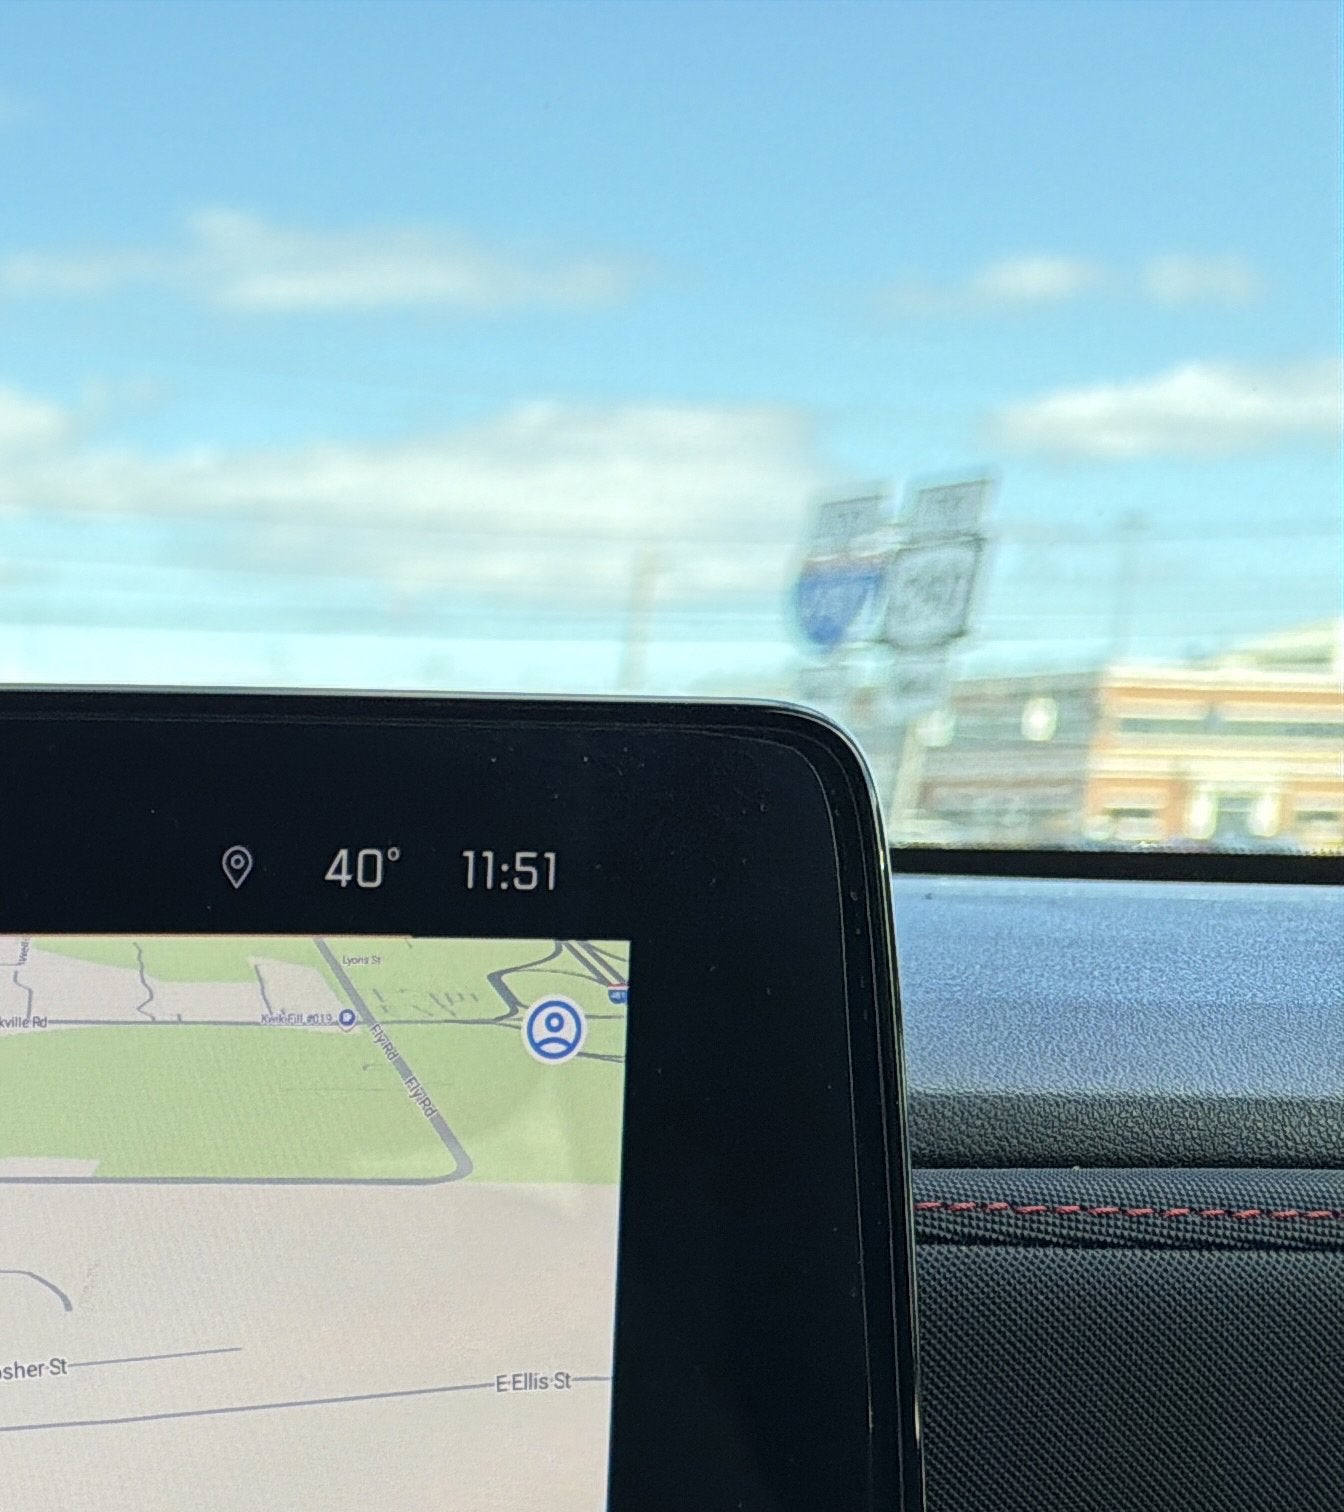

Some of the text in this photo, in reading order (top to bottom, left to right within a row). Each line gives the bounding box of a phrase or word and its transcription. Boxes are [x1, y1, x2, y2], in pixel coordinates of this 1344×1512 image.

[324, 847, 401, 889] 40°
[462, 850, 557, 891] 11:51
[342, 956, 382, 967] Lyons St
[32, 1017, 48, 1028] Rd
[370, 1024, 400, 1061] Fly Rd
[405, 1076, 438, 1119] Fly Rd
[48, 1358, 68, 1376] St
[495, 1371, 572, 1392] E Ellis St
